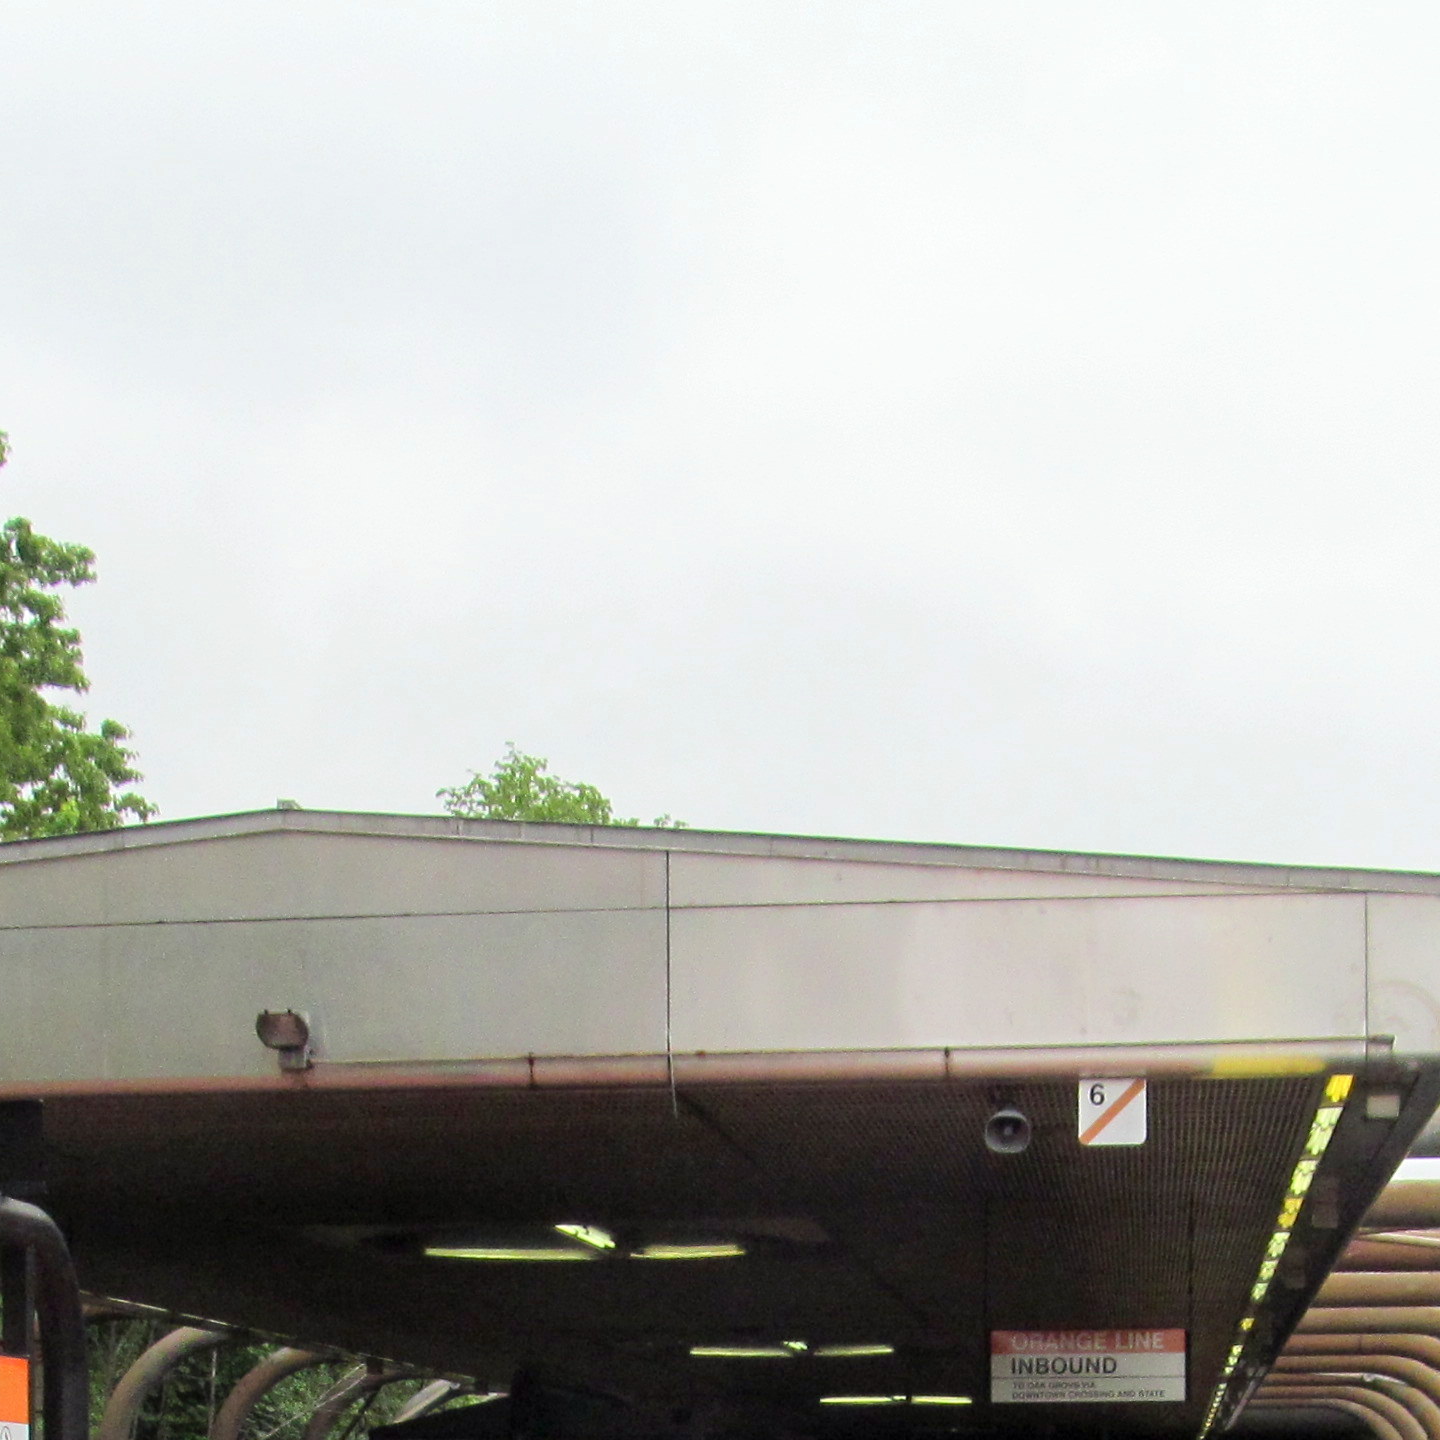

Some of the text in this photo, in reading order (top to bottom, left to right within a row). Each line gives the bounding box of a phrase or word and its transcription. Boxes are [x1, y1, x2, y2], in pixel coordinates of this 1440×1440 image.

[1090, 1083, 1105, 1106] 6
[1010, 1331, 1164, 1351] ORANGE LINE
[1011, 1356, 1117, 1375] INBOUND
[1138, 1389, 1166, 1397] STATE
